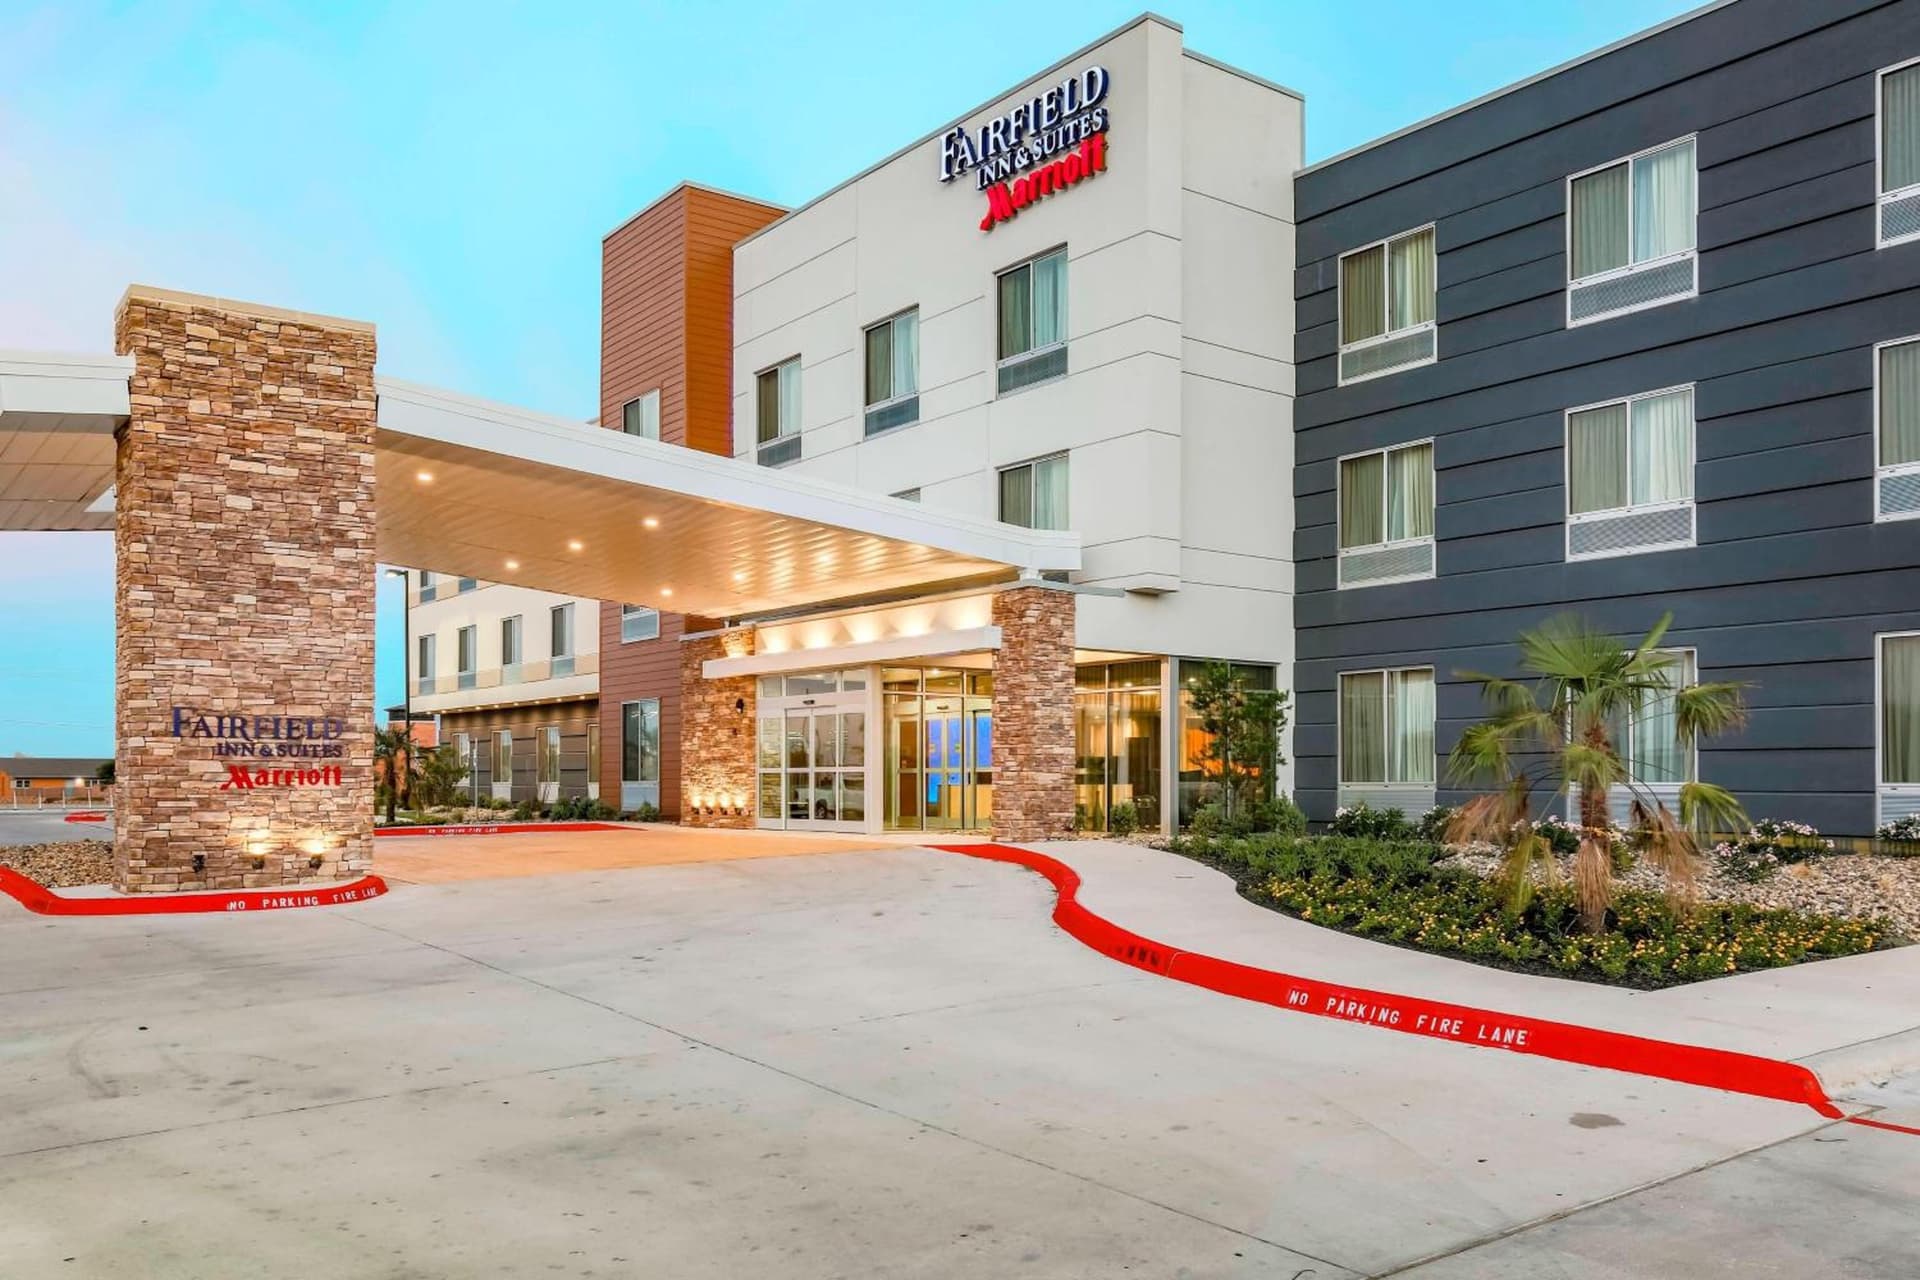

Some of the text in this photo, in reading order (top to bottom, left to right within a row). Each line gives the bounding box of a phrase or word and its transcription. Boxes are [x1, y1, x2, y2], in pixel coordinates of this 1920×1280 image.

[939, 65, 1110, 184] FAIRFIELD
[976, 106, 1110, 190] INN & SUITES
[979, 131, 1109, 232] Marriott
[172, 706, 343, 741] FAIRFIELD
[216, 742, 343, 758] INN & SUITES
[220, 764, 342, 791] Marriott
[229, 901, 246, 910] NO
[262, 897, 319, 908] PARKING
[333, 891, 358, 903] FIRE
[1289, 990, 1528, 1046] NO PARKING FIRE LANE
